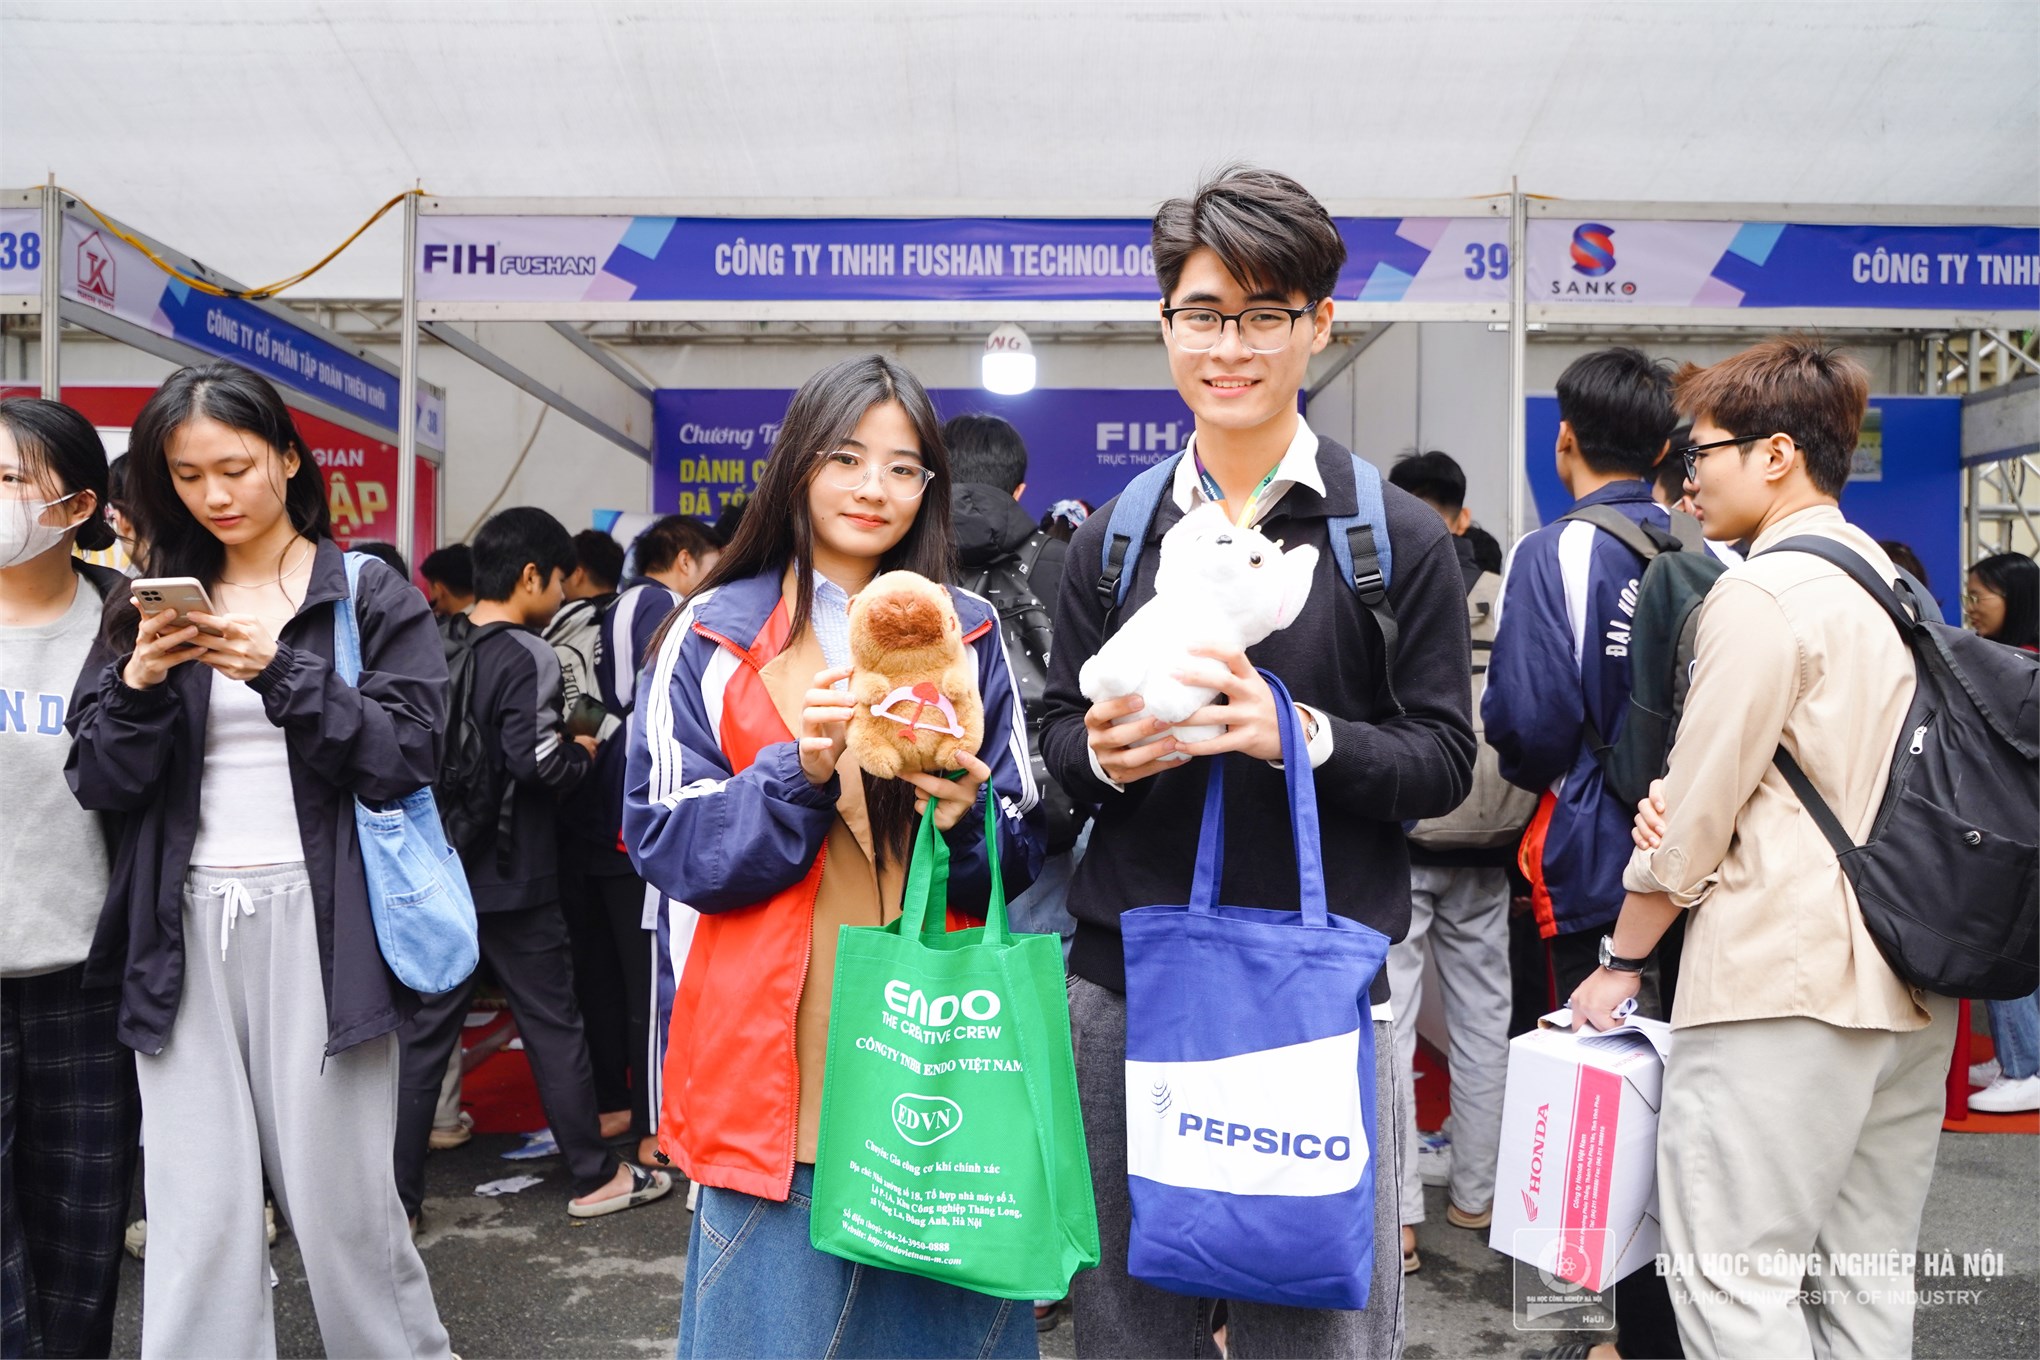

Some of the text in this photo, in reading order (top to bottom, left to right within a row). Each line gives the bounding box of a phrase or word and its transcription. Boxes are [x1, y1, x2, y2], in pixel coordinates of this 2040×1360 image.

[0, 232, 40, 270] 38
[423, 244, 596, 275] FIH FUSHAN
[714, 237, 1156, 276] CÔNG TY TNHH FUSHAN TECHNOLOG
[1464, 243, 1509, 281] 39
[1852, 246, 1929, 285] CÔNG
[1937, 254, 1969, 285] TY
[1551, 280, 1637, 296] SANKO
[207, 308, 238, 345] CÔNG
[240, 324, 253, 351] TY
[300, 351, 317, 381] TẬP
[427, 410, 437, 435] 38
[679, 422, 754, 450] Chương
[1096, 423, 1177, 451] FIH
[680, 454, 745, 484] DÀNH
[1096, 454, 1127, 467] TRỰC
[330, 471, 388, 534] ẬP
[679, 487, 712, 516] ĐÃ
[1606, 620, 1632, 657] ĐẠI
[884, 979, 1001, 1027] ENDO
[882, 1011, 1002, 1044] THE CREATIVE CREW
[900, 1053, 922, 1075] TNHH
[923, 1059, 956, 1076] ENDO
[958, 1057, 991, 1073] VIỆT
[993, 1059, 1023, 1072] NAM
[897, 1104, 951, 1131] EDVN
[1178, 1112, 1350, 1161] PEPSICO
[1529, 1103, 1551, 1196] HONDA
[902, 1160, 921, 1176] công
[923, 1164, 934, 1173] cơ
[935, 1161, 952, 1172] khí
[953, 1162, 981, 1173] chính
[983, 1163, 1001, 1174] xác
[911, 1191, 923, 1201] 18,
[958, 1191, 975, 1201] nhà
[976, 1193, 994, 1204] máy
[996, 1191, 1006, 1203] số
[1008, 1194, 1016, 1205] 3,
[911, 1203, 935, 1215] Công
[936, 1203, 966, 1215] nghiệp
[997, 1206, 1022, 1219] Long,
[928, 1216, 950, 1227] Anh,
[952, 1216, 965, 1226] Hà
[967, 1217, 982, 1229] Nội
